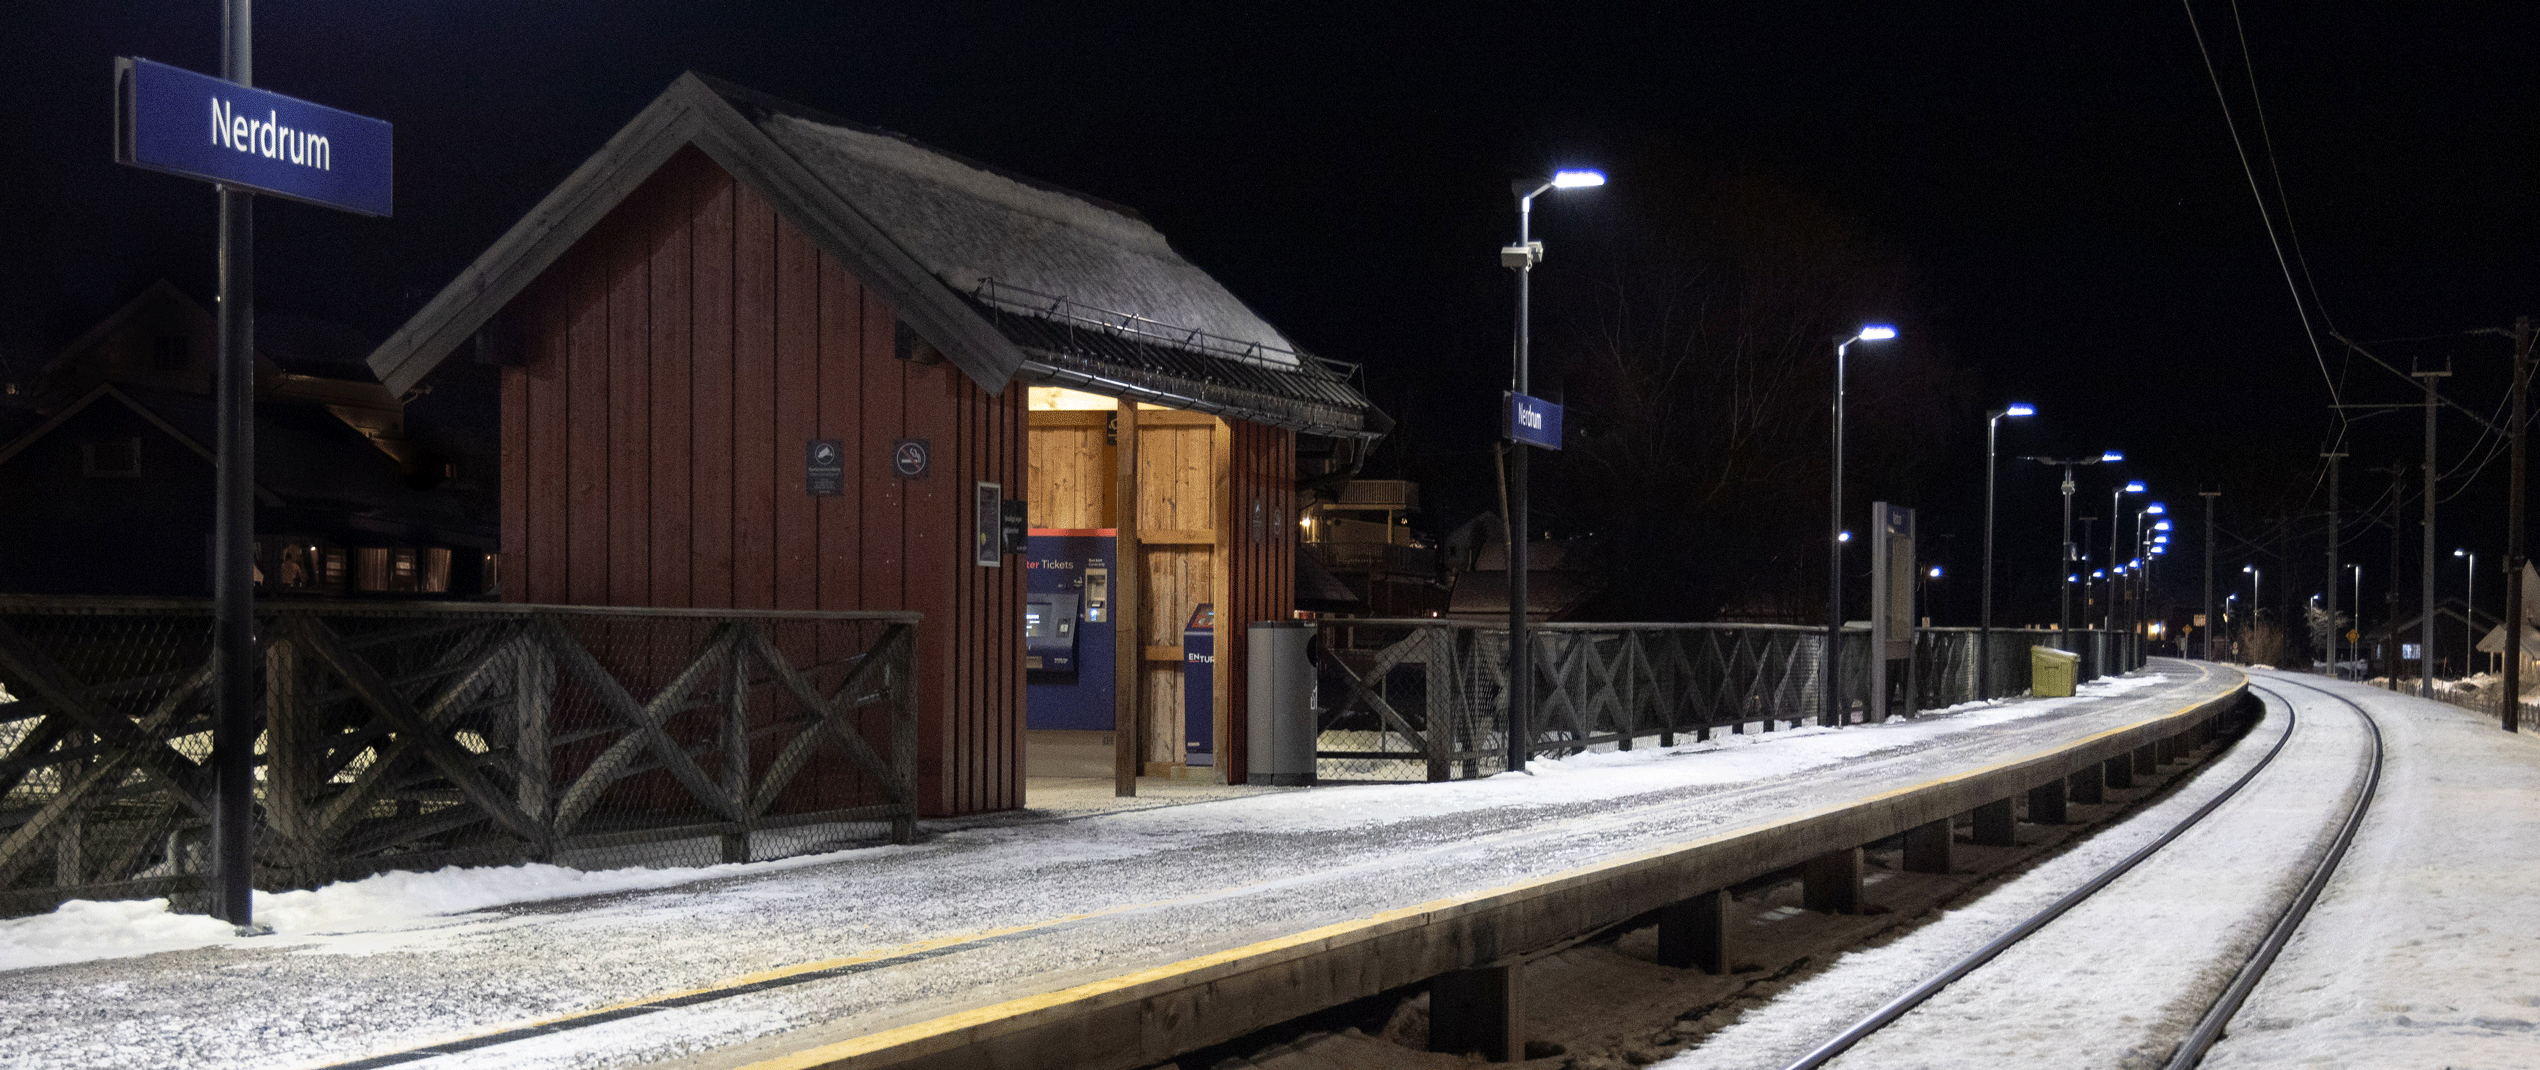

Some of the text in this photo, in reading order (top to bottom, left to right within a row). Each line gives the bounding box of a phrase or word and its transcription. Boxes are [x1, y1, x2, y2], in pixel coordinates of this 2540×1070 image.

[212, 97, 330, 171] Nerdrum
[1518, 402, 1541, 430] Nerdrum
[1042, 559, 1074, 569] Tickets
